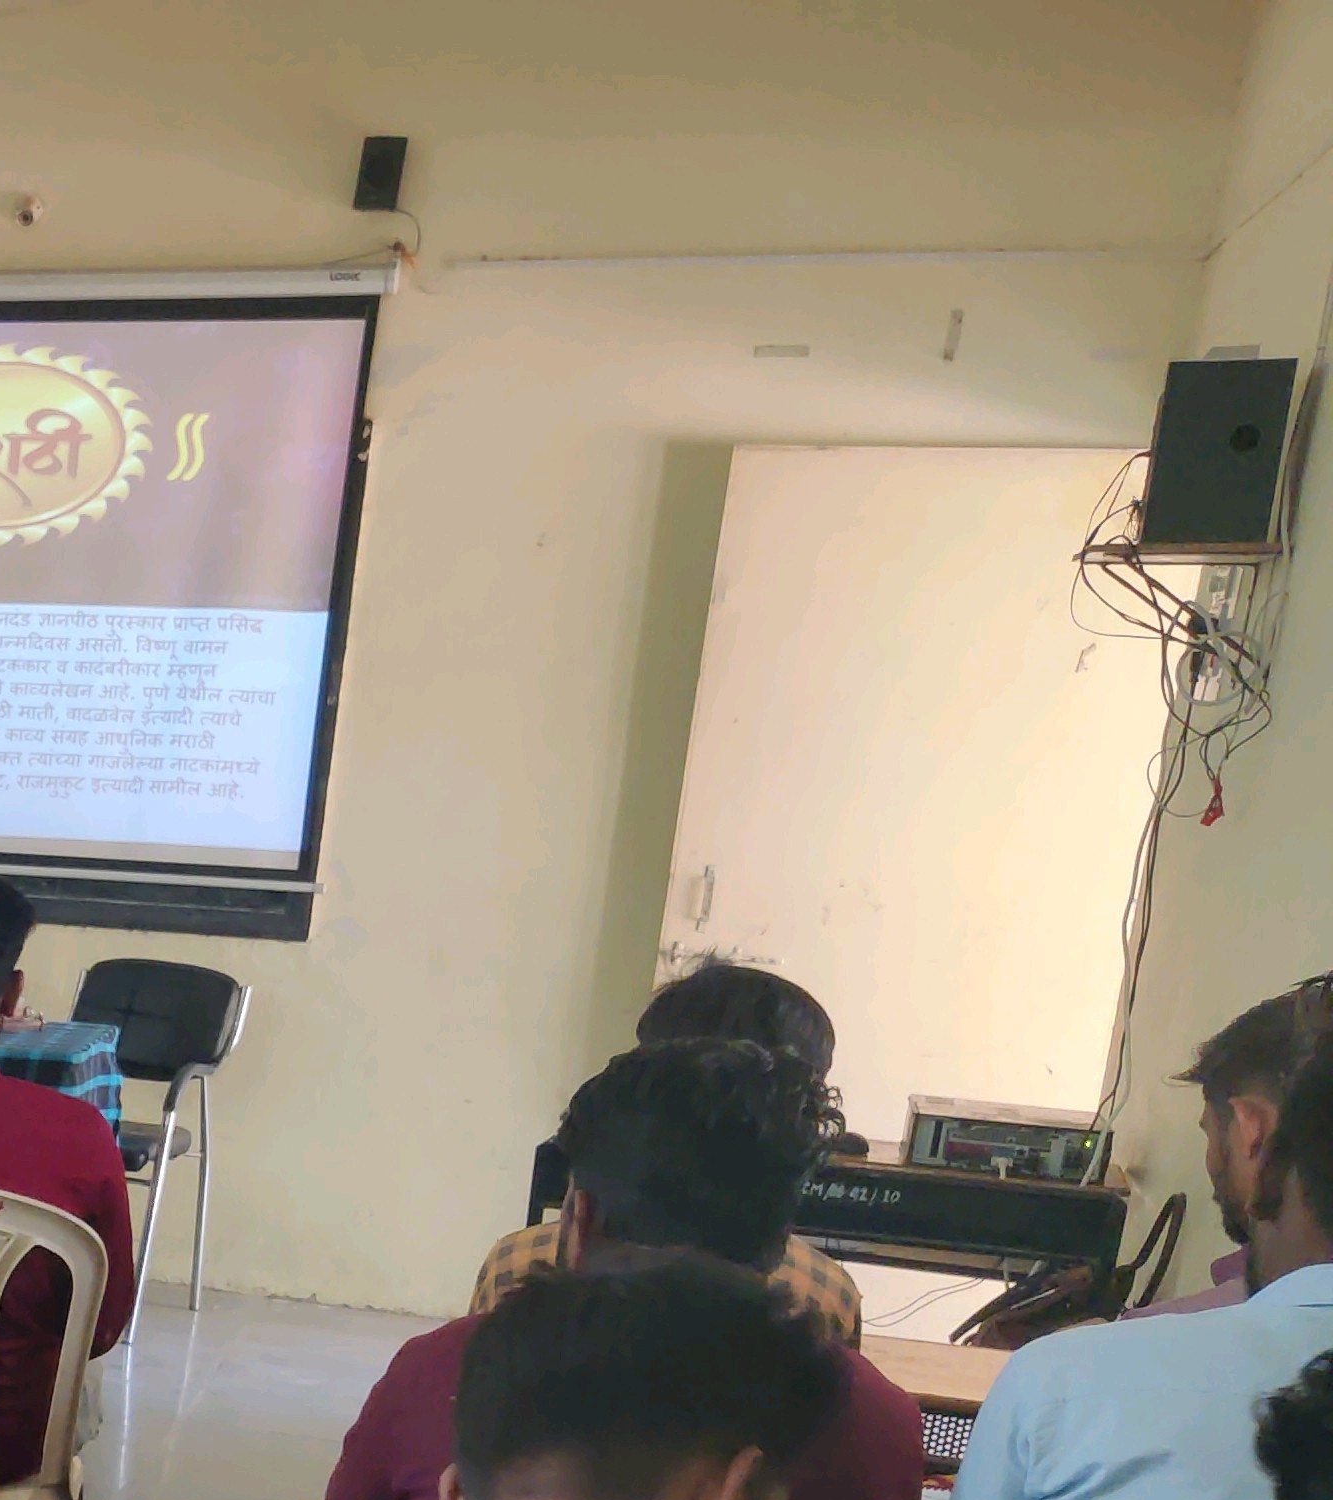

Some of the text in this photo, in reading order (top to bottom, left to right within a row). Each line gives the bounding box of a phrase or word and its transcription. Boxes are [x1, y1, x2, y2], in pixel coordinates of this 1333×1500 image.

[105, 615, 167, 637] पुरस्कार
[184, 640, 229, 654] वामन
[56, 661, 69, 674] व
[95, 729, 164, 755] आधुनिक
[169, 730, 216, 749] मराठी
